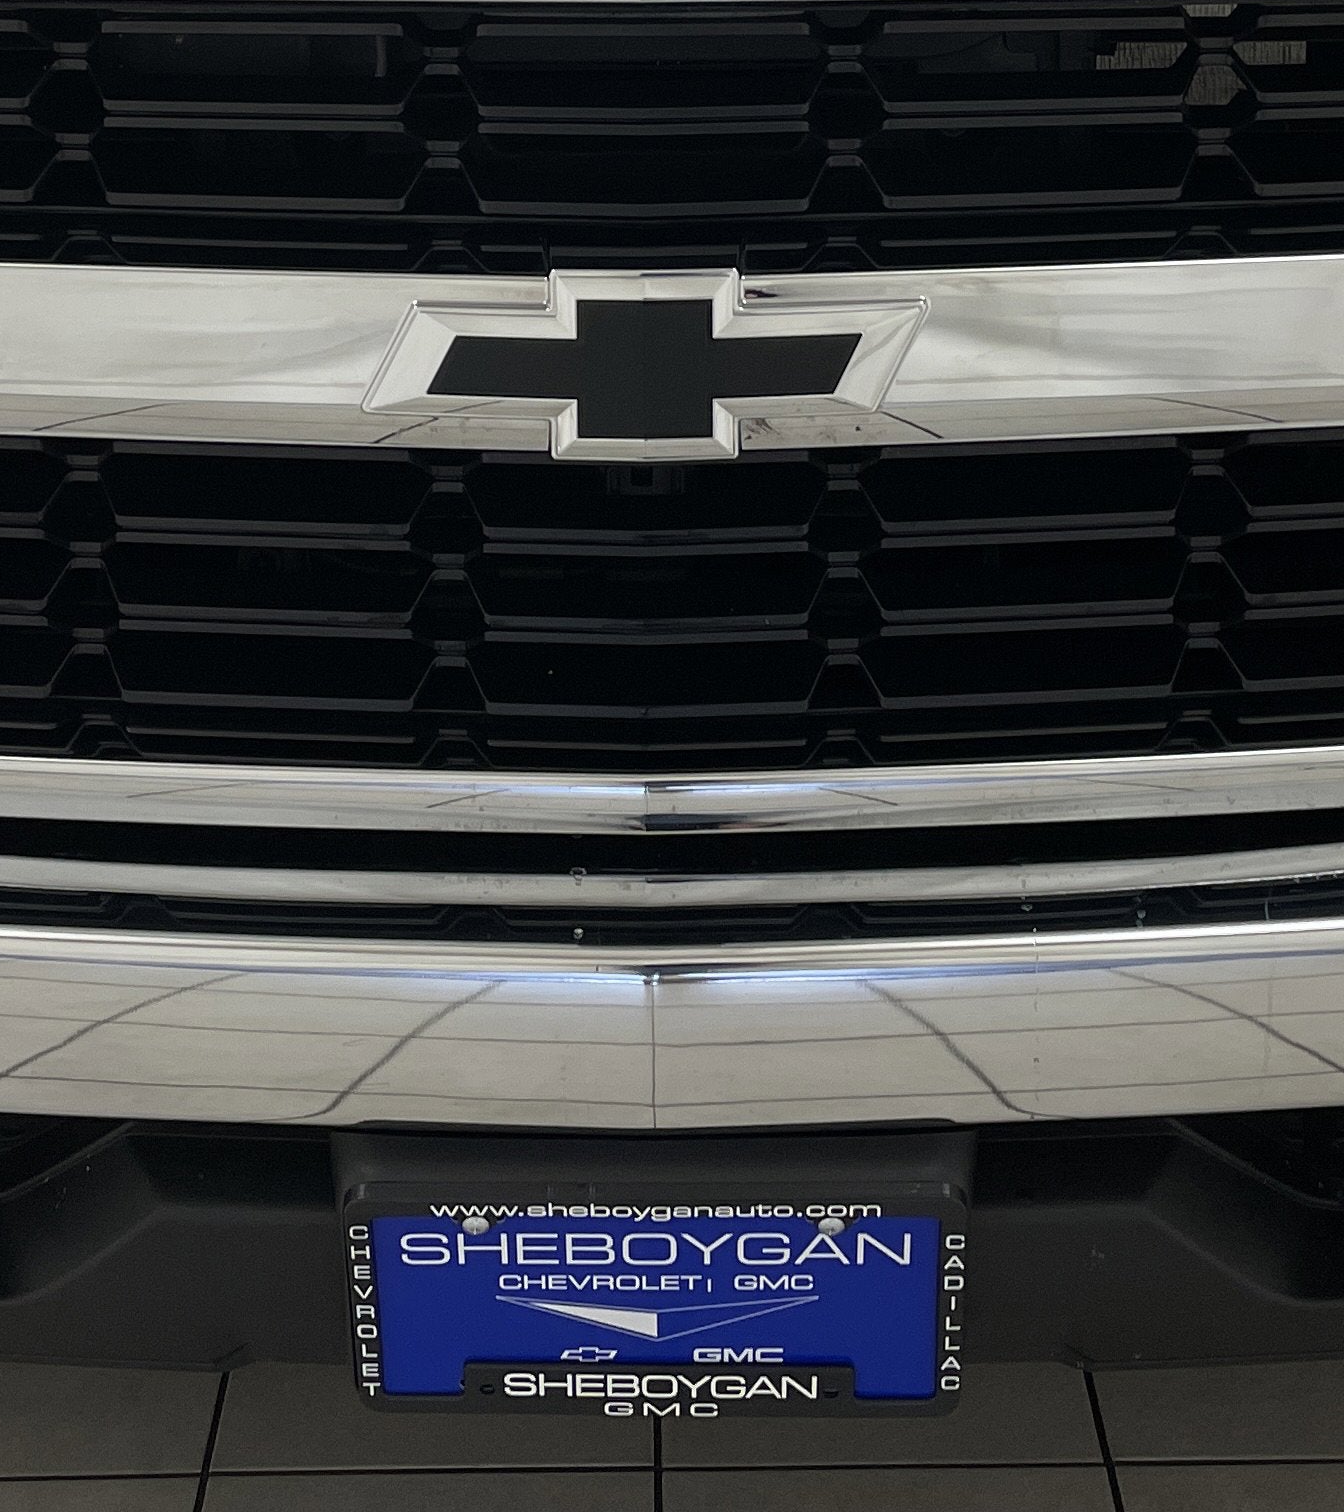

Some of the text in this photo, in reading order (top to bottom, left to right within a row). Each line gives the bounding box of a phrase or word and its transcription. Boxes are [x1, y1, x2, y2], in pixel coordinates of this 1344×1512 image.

[429, 1201, 882, 1223] www.sheboyganauto.com
[399, 1232, 912, 1265] SHEBOYGAN
[498, 1274, 814, 1291] CHEVROLET GMC
[348, 1224, 382, 1397] CHEVROLET
[940, 1234, 966, 1391] CADILLAC
[692, 1347, 784, 1363] GMC
[503, 1372, 818, 1400] SHEBOYGAN
[604, 1401, 719, 1418] GMC
